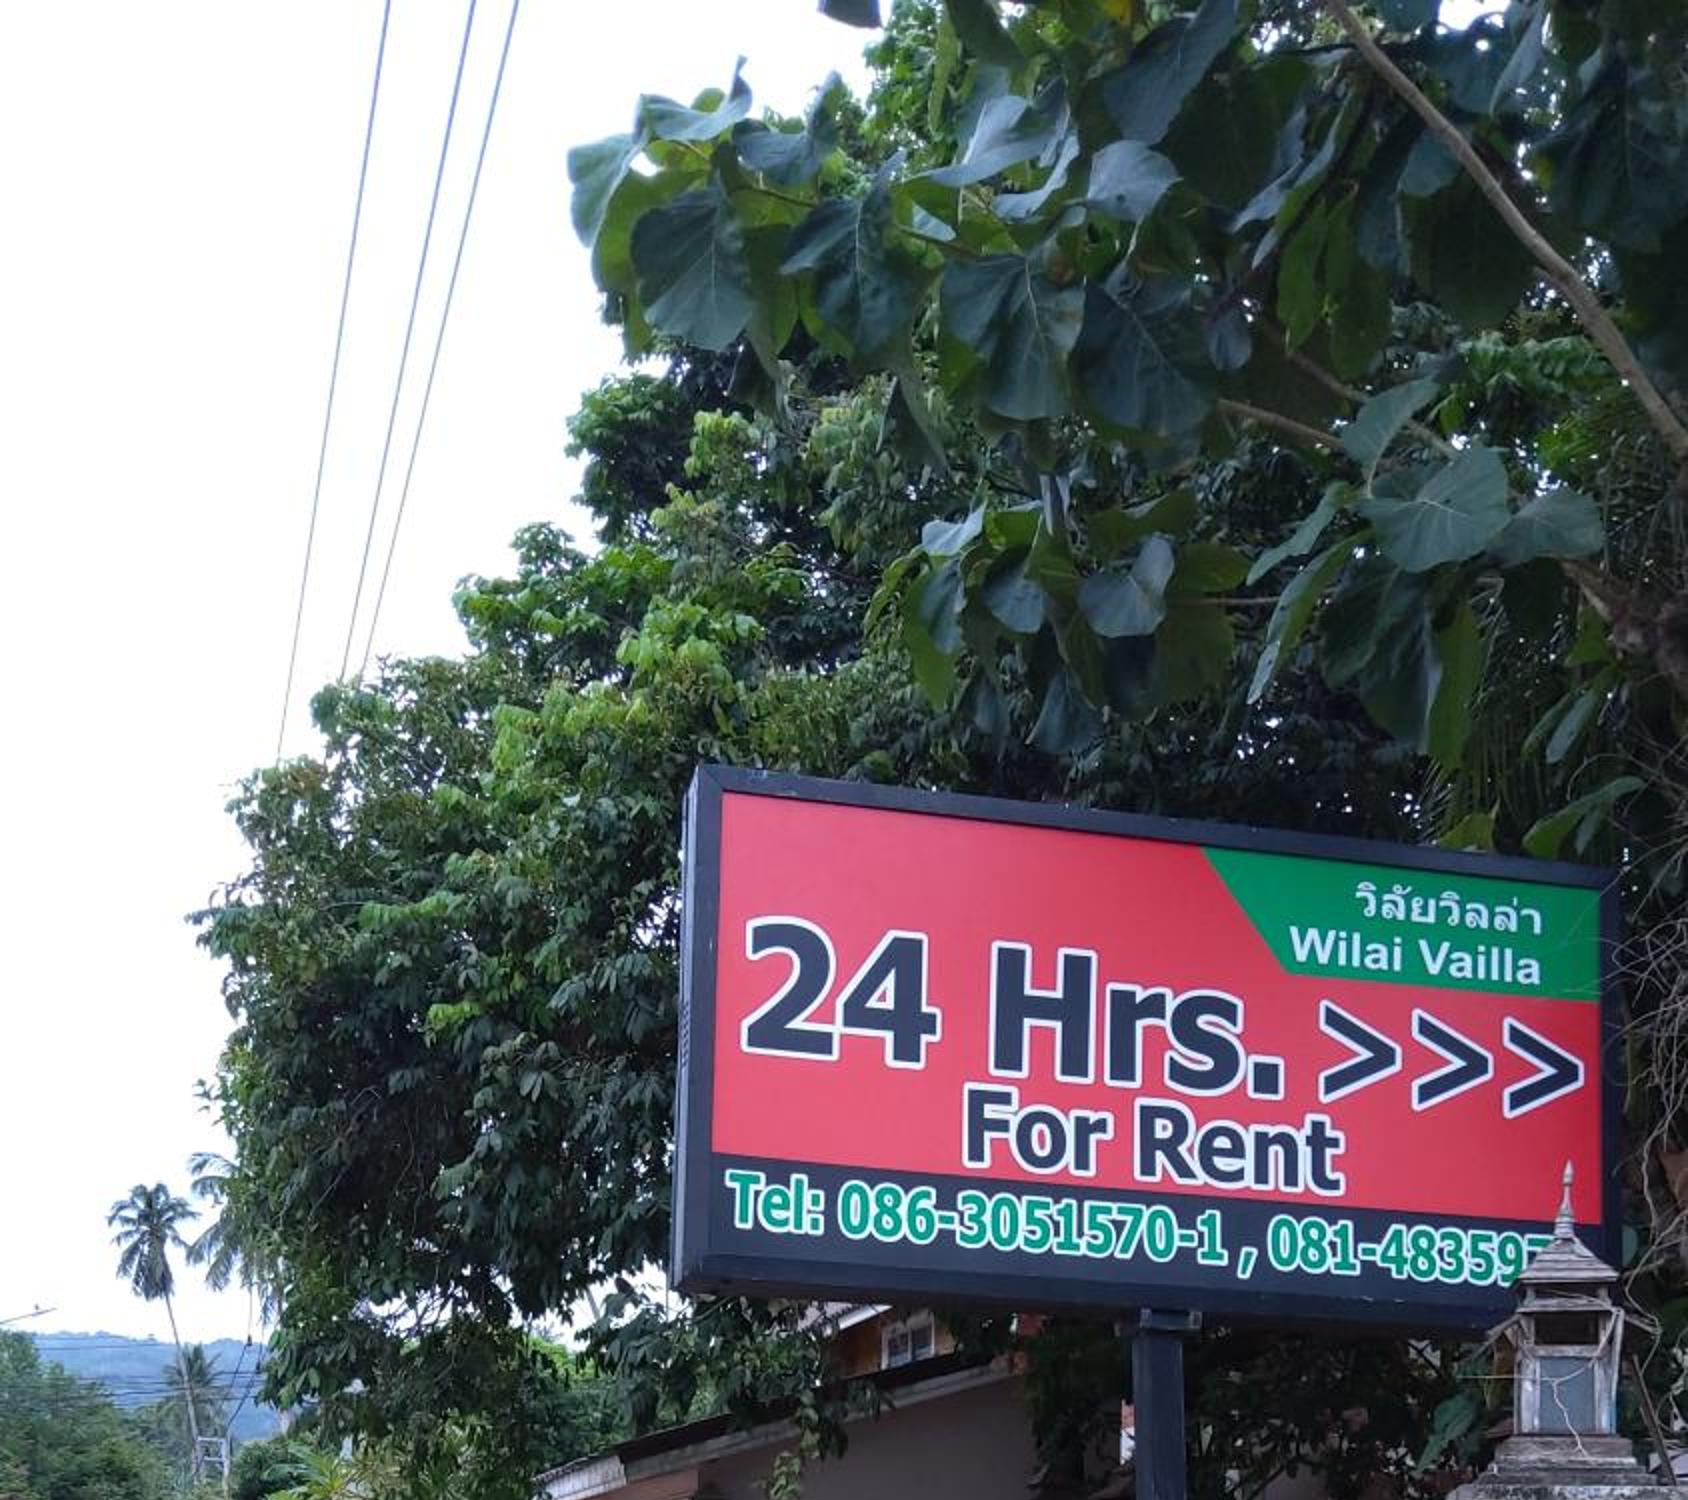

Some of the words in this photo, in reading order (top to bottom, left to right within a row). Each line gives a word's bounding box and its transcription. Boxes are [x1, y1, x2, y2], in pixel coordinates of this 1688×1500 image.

[1289, 925, 1402, 972] Wilai
[1418, 938, 1541, 985] Vailla
[1355, 881, 1543, 935] วิลัยวิลล่า
[742, 917, 940, 1067] 24
[991, 942, 1283, 1096] Hrs.
[964, 1084, 1112, 1175] For
[1136, 1100, 1344, 1194] Rent
[725, 1170, 826, 1235] Tel:
[838, 1181, 1228, 1267] 086-3051570-1
